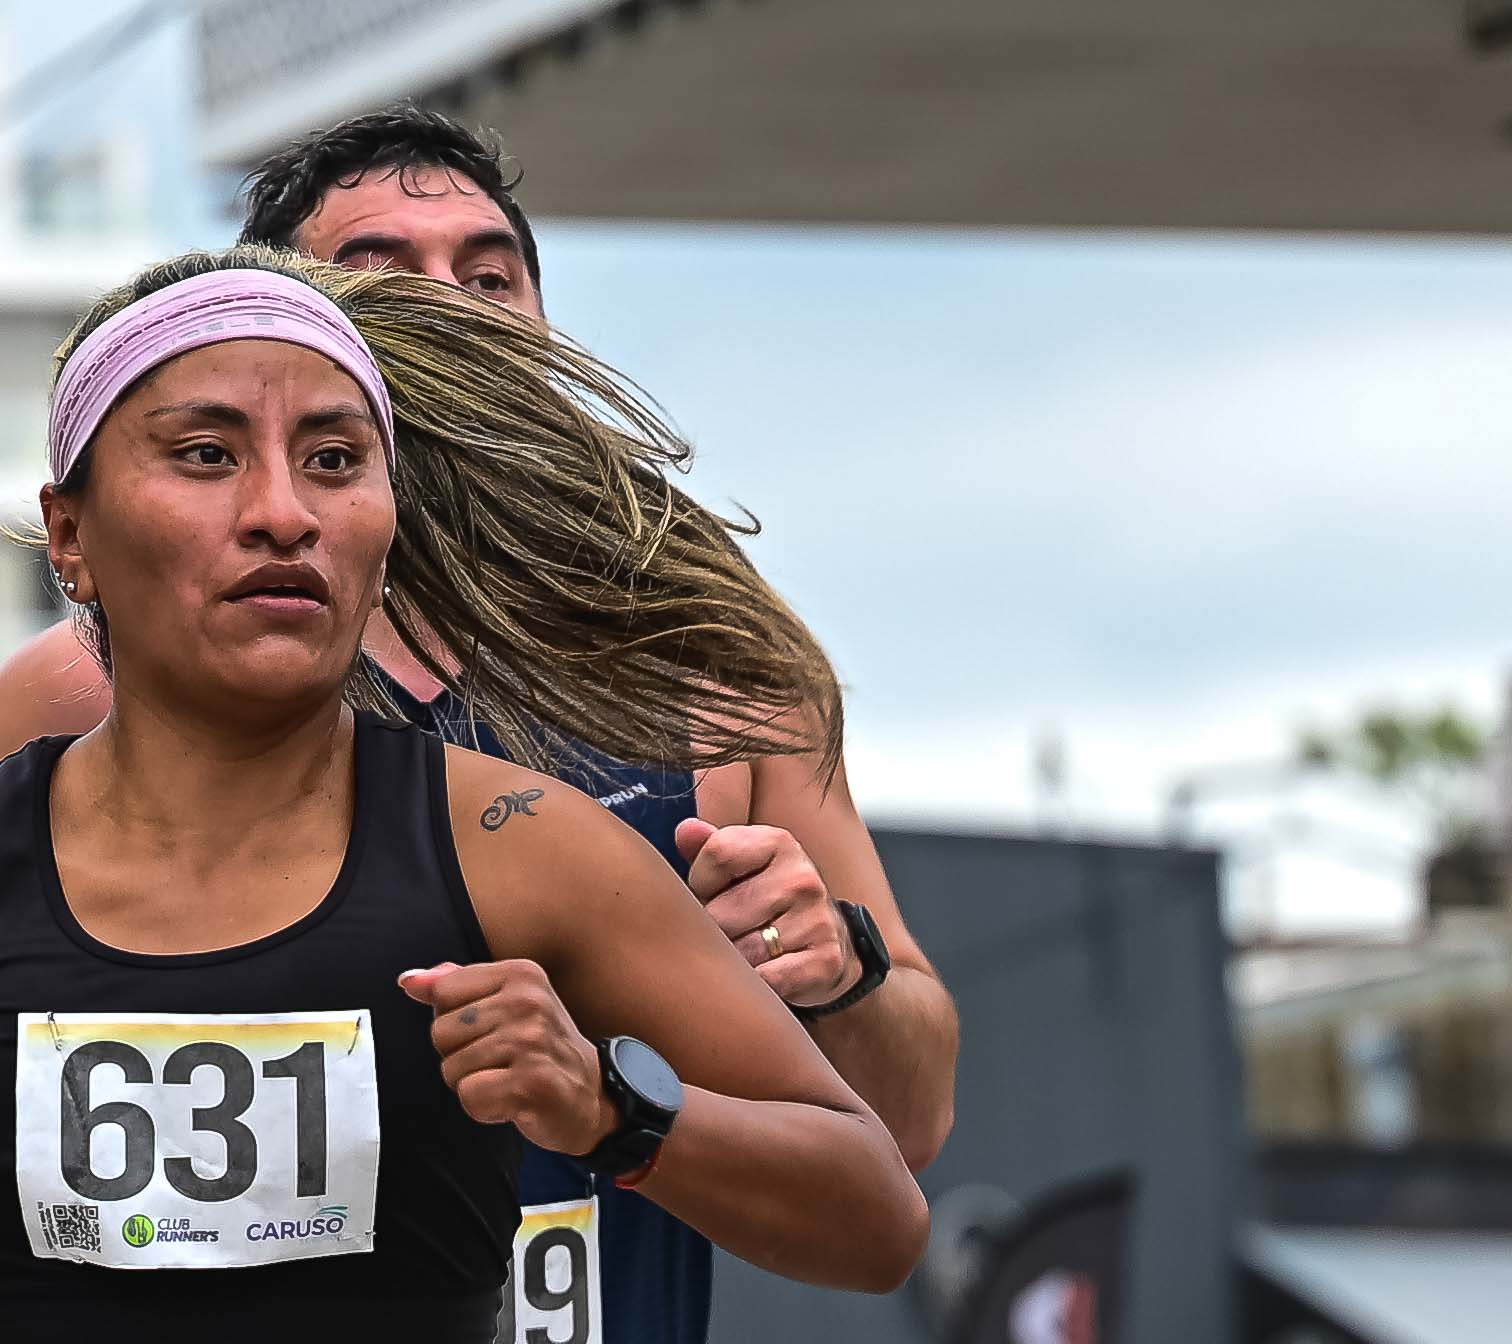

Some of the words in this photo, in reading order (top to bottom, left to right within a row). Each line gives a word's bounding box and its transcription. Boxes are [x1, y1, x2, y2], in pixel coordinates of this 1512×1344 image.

[59, 1040, 327, 1202] 631
[157, 1218, 191, 1231] CLUB
[246, 1216, 344, 1242] CARUSO
